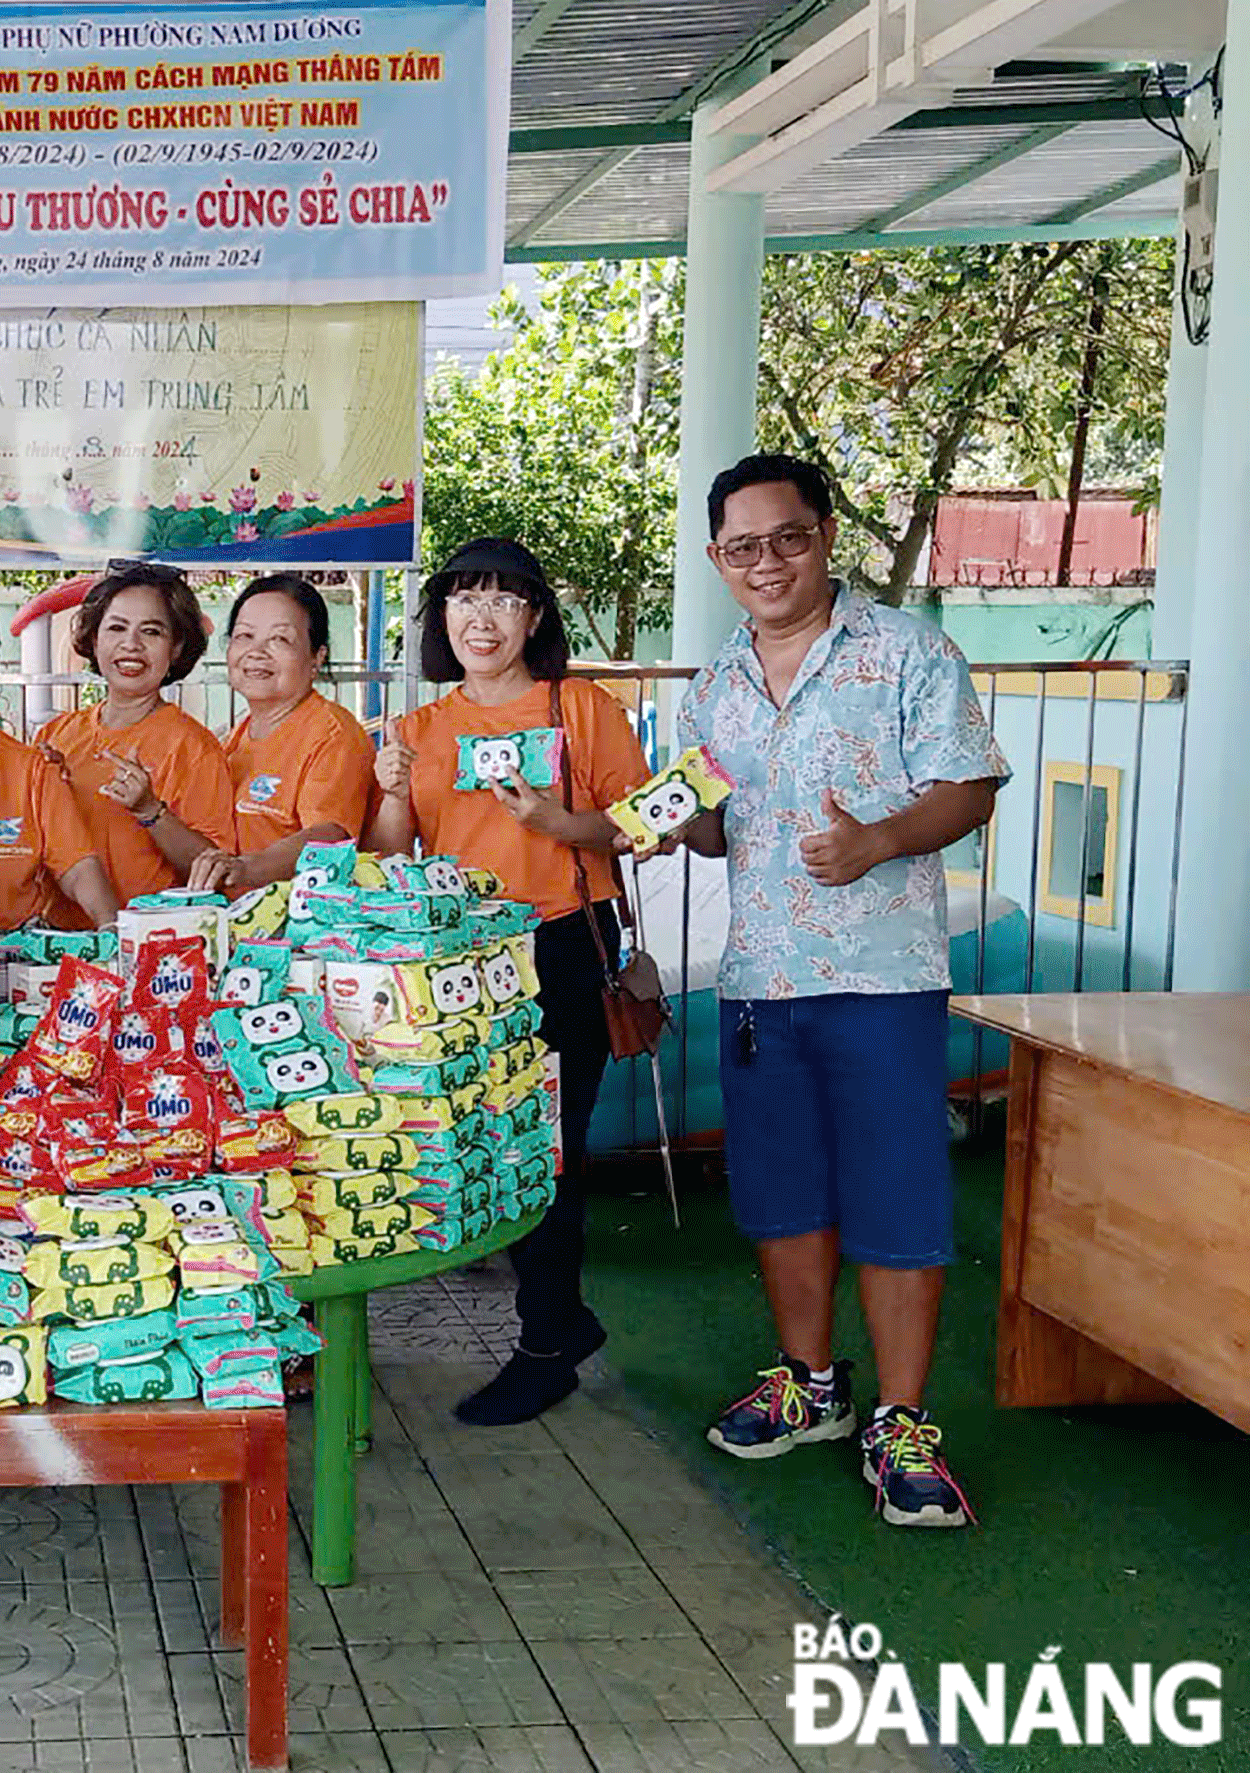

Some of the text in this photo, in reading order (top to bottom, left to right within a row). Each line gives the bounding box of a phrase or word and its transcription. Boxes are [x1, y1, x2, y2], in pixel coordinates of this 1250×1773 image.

[2, 26, 50, 57] PHỤ
[59, 22, 93, 47] NỮ
[98, 21, 202, 48] PHƯỜNG
[210, 22, 267, 45] NAM
[274, 18, 362, 43] DƯƠNG
[27, 72, 59, 93] 79
[66, 64, 127, 93] NĂM
[135, 62, 204, 90] CÁCH
[212, 62, 289, 91] MẠNG
[296, 54, 381, 84] THÁNG
[388, 51, 441, 82] TÁM
[49, 102, 119, 131] NƯỚC
[127, 104, 232, 130] CHXHCN
[240, 97, 293, 132] VIỆT
[300, 102, 358, 127] NAM
[112, 141, 379, 167] (02/9/1945-02/9/2024)
[25, 186, 169, 231] THƯƠNG
[195, 179, 289, 228] CÙNG
[299, 172, 339, 227] SẺ
[14, 253, 60, 275] ngày
[66, 252, 88, 270] 24
[92, 250, 148, 272] tháng
[152, 251, 164, 269] 8
[169, 251, 211, 269] năm
[216, 249, 262, 267] 2024
[77, 306, 113, 350] CÁ
[16, 365, 64, 409] TRẺ
[83, 379, 125, 409] EM
[140, 379, 232, 414] TRUNG
[151, 972, 192, 996] OMO
[58, 999, 98, 1029] OMO
[113, 1031, 155, 1051] OMO
[148, 1096, 190, 1118] OMO
